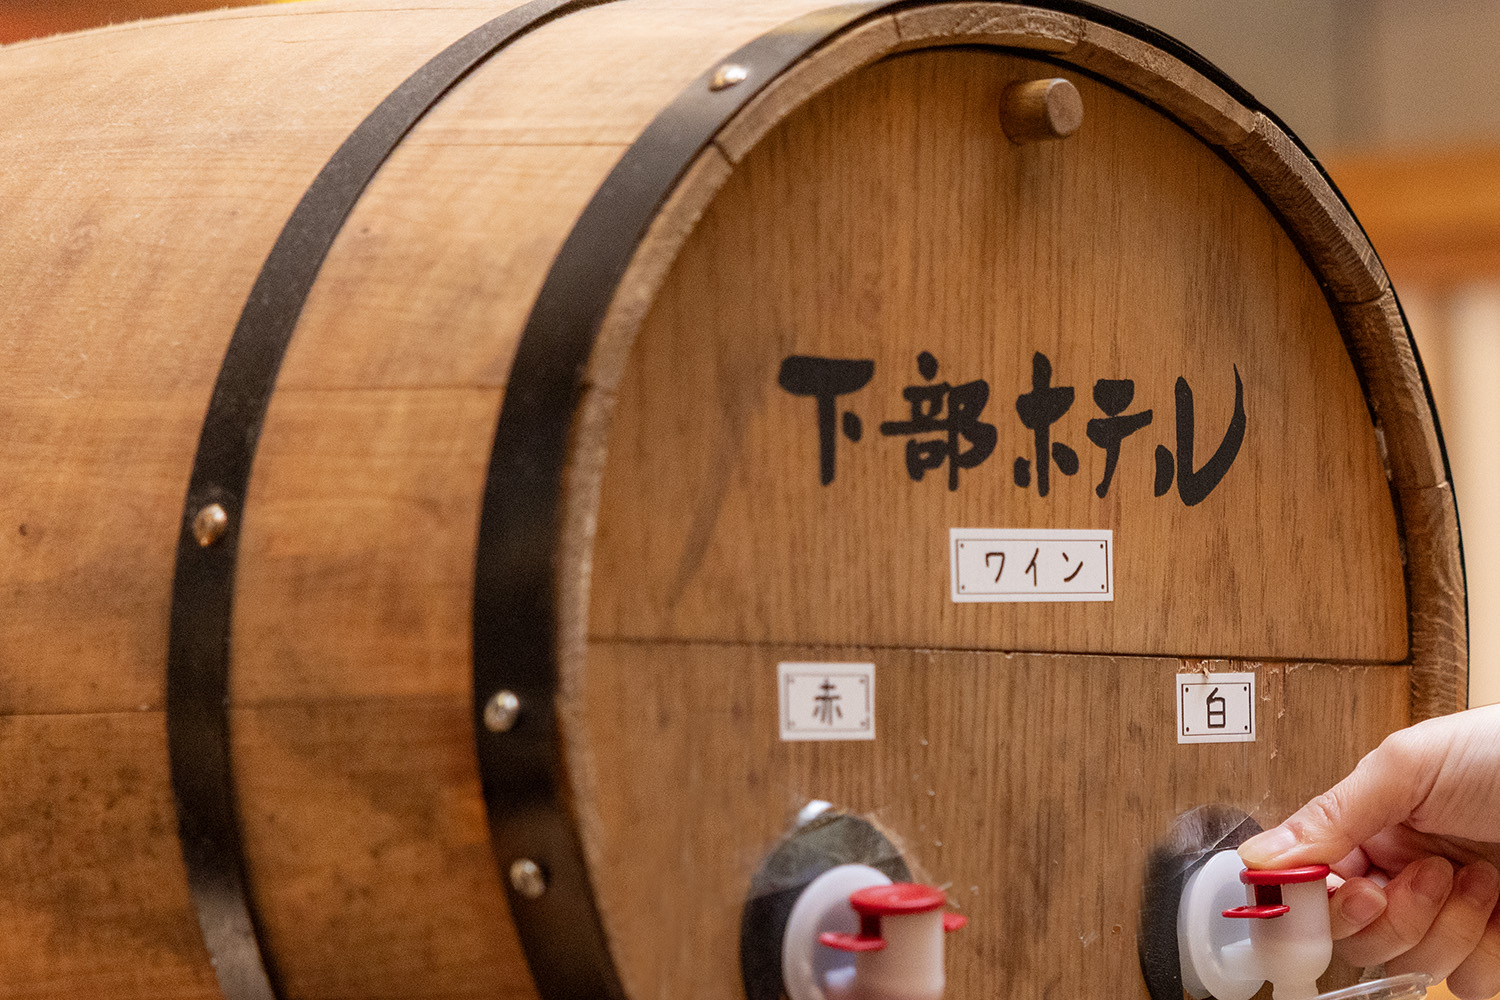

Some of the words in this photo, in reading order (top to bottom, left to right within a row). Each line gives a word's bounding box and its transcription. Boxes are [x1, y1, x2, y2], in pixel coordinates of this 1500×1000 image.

[778, 350, 1247, 506] 下部ホテル
[984, 547, 1084, 587] ワイン
[812, 679, 843, 726] 赤
[1206, 687, 1226, 729] 白
